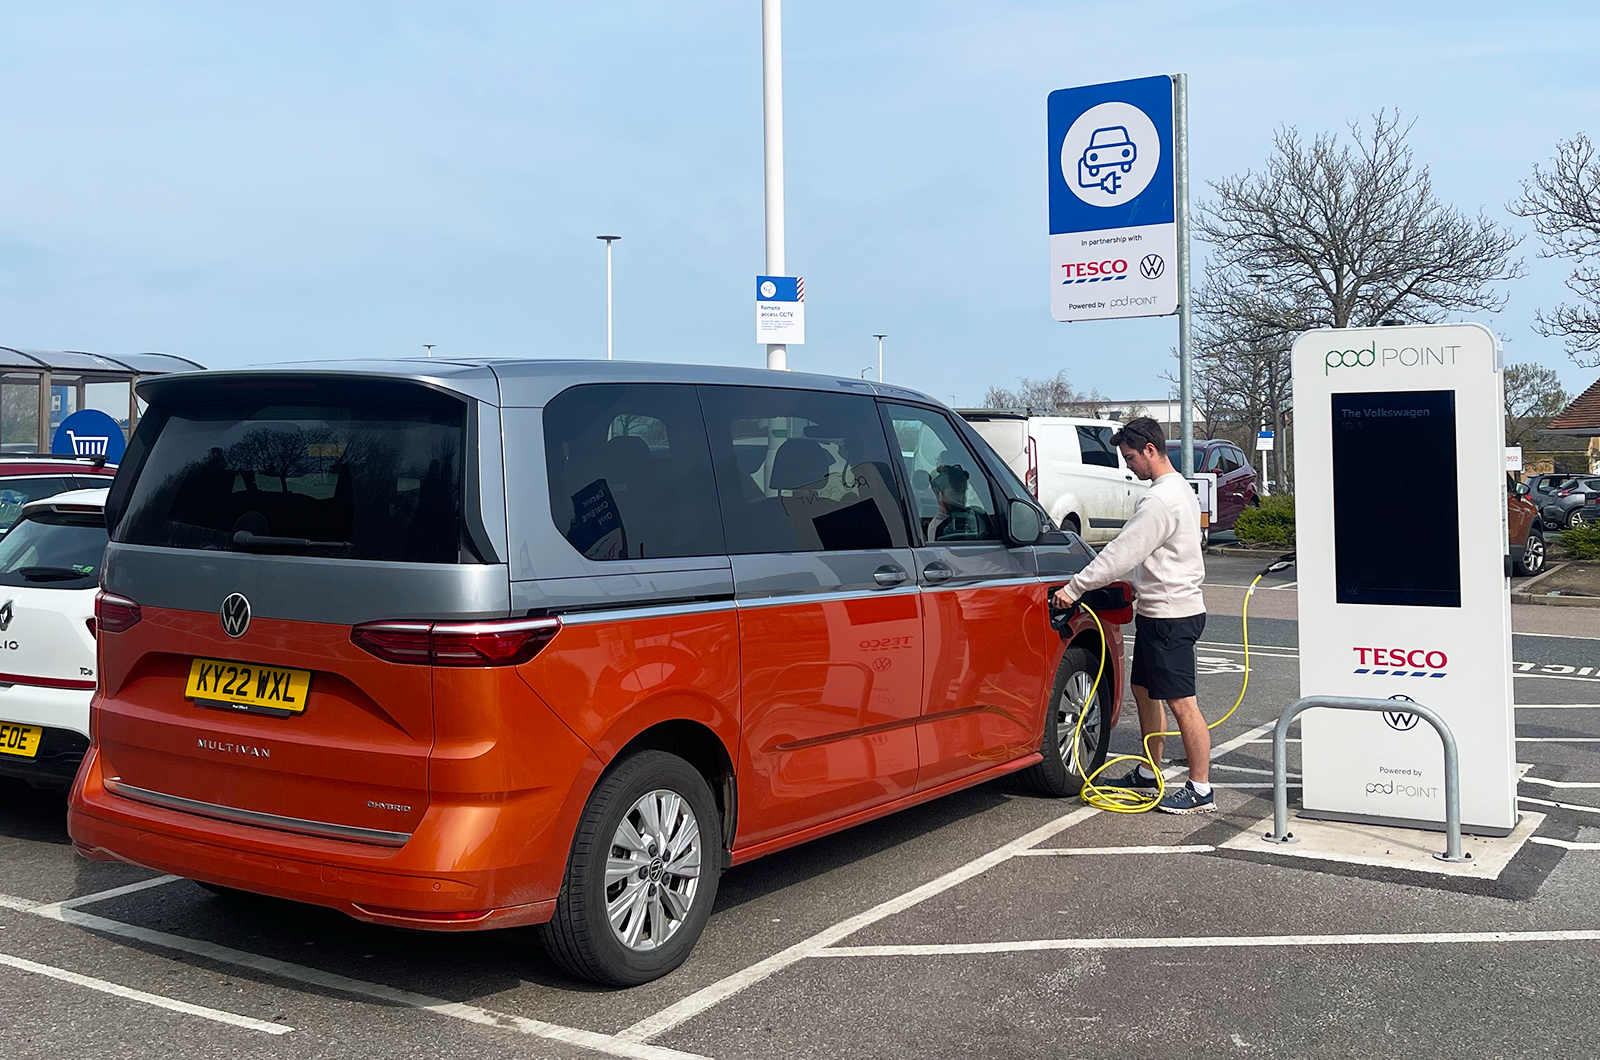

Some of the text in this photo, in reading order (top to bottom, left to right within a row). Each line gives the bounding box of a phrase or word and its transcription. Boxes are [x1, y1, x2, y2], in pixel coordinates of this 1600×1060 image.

[1088, 236, 1127, 247] partnership
[1062, 259, 1128, 278] TESCO
[1068, 302, 1097, 310] Powered
[1109, 295, 1157, 310] pod POINT
[1325, 340, 1462, 377] pod POINT
[1341, 408, 1431, 419] The Volkswagen
[1353, 647, 1447, 669] TESCO
[196, 663, 295, 703] KY22 WXL
[197, 739, 271, 758] MULTIVAN
[1380, 766, 1422, 777] Powered by
[1366, 780, 1439, 799] pod POINT
